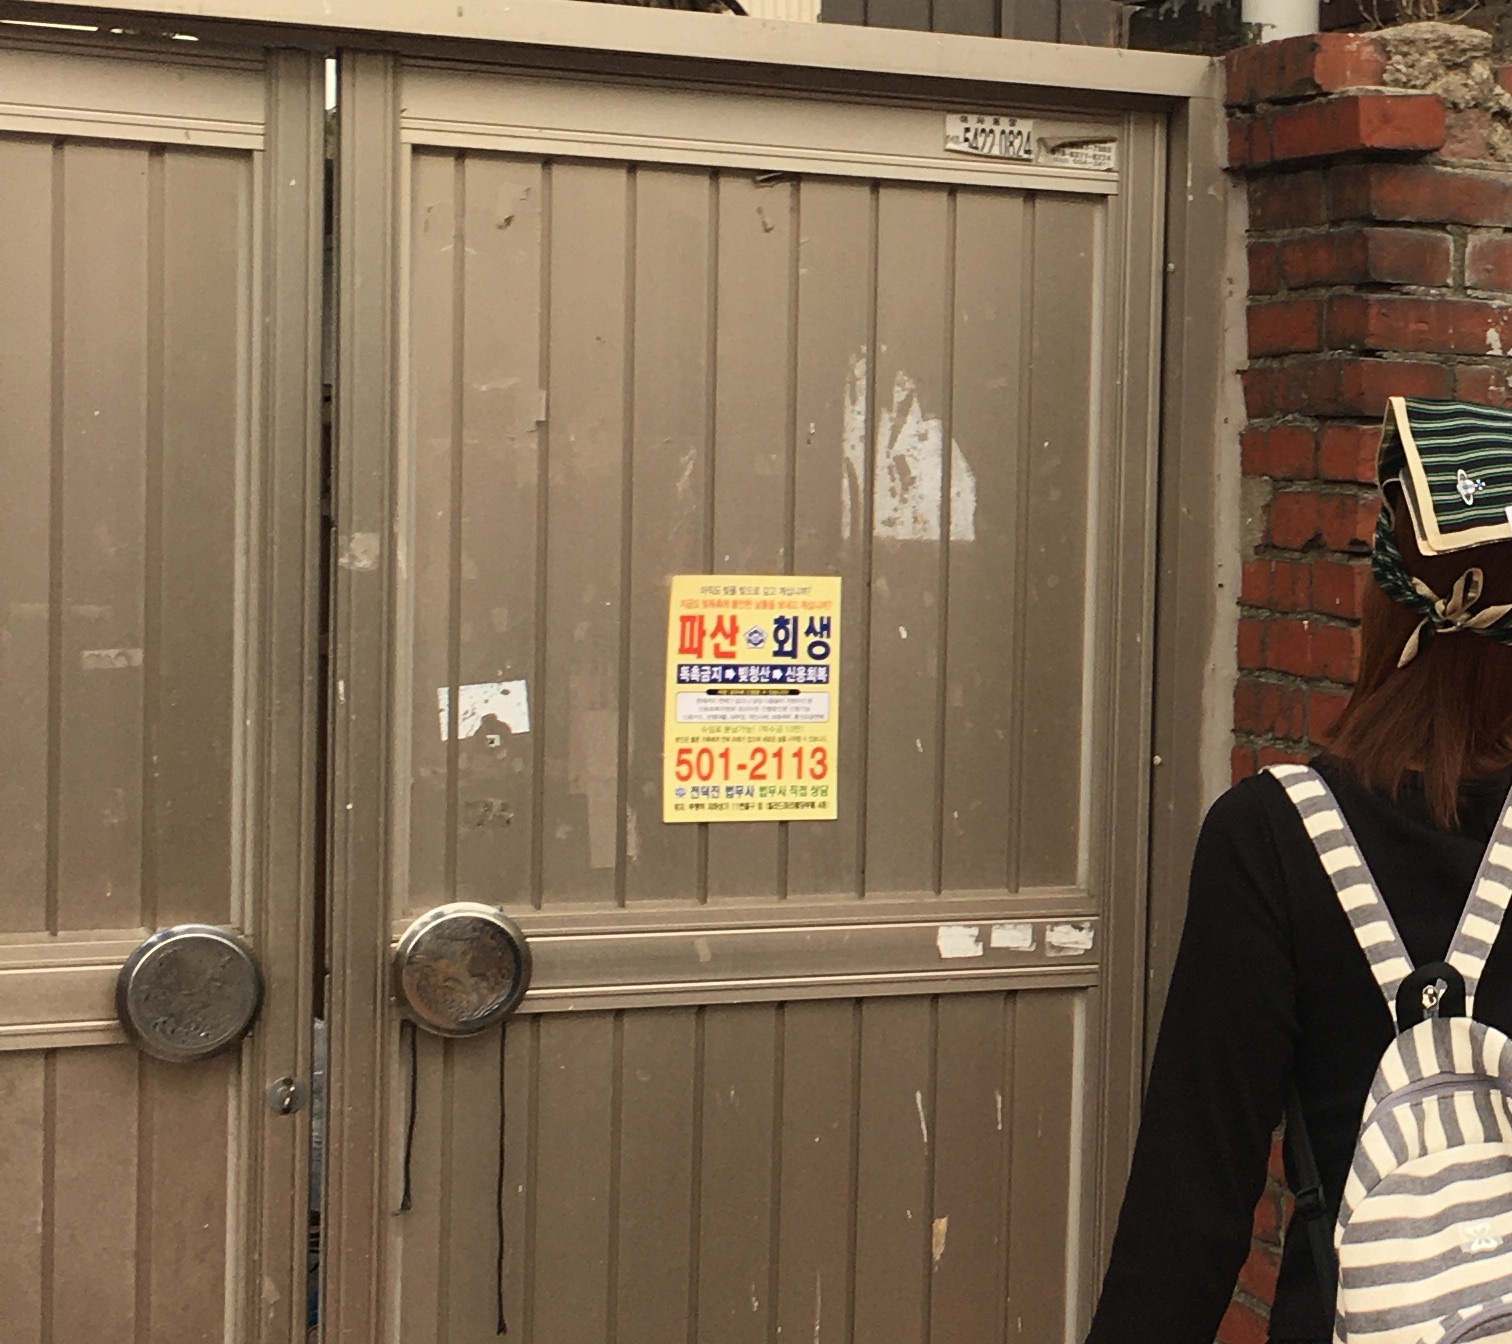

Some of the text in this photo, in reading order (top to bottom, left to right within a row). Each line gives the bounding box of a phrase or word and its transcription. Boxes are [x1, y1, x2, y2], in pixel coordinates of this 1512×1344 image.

[677, 614, 831, 660] 파산 회생
[679, 665, 828, 683] 독촉금지 빚청산 신용회복
[675, 746, 828, 782] 501-2113
[725, 785, 755, 798] 법무사
[759, 785, 787, 798] 법무사
[789, 785, 808, 798] 직접
[810, 785, 829, 797] 상담
